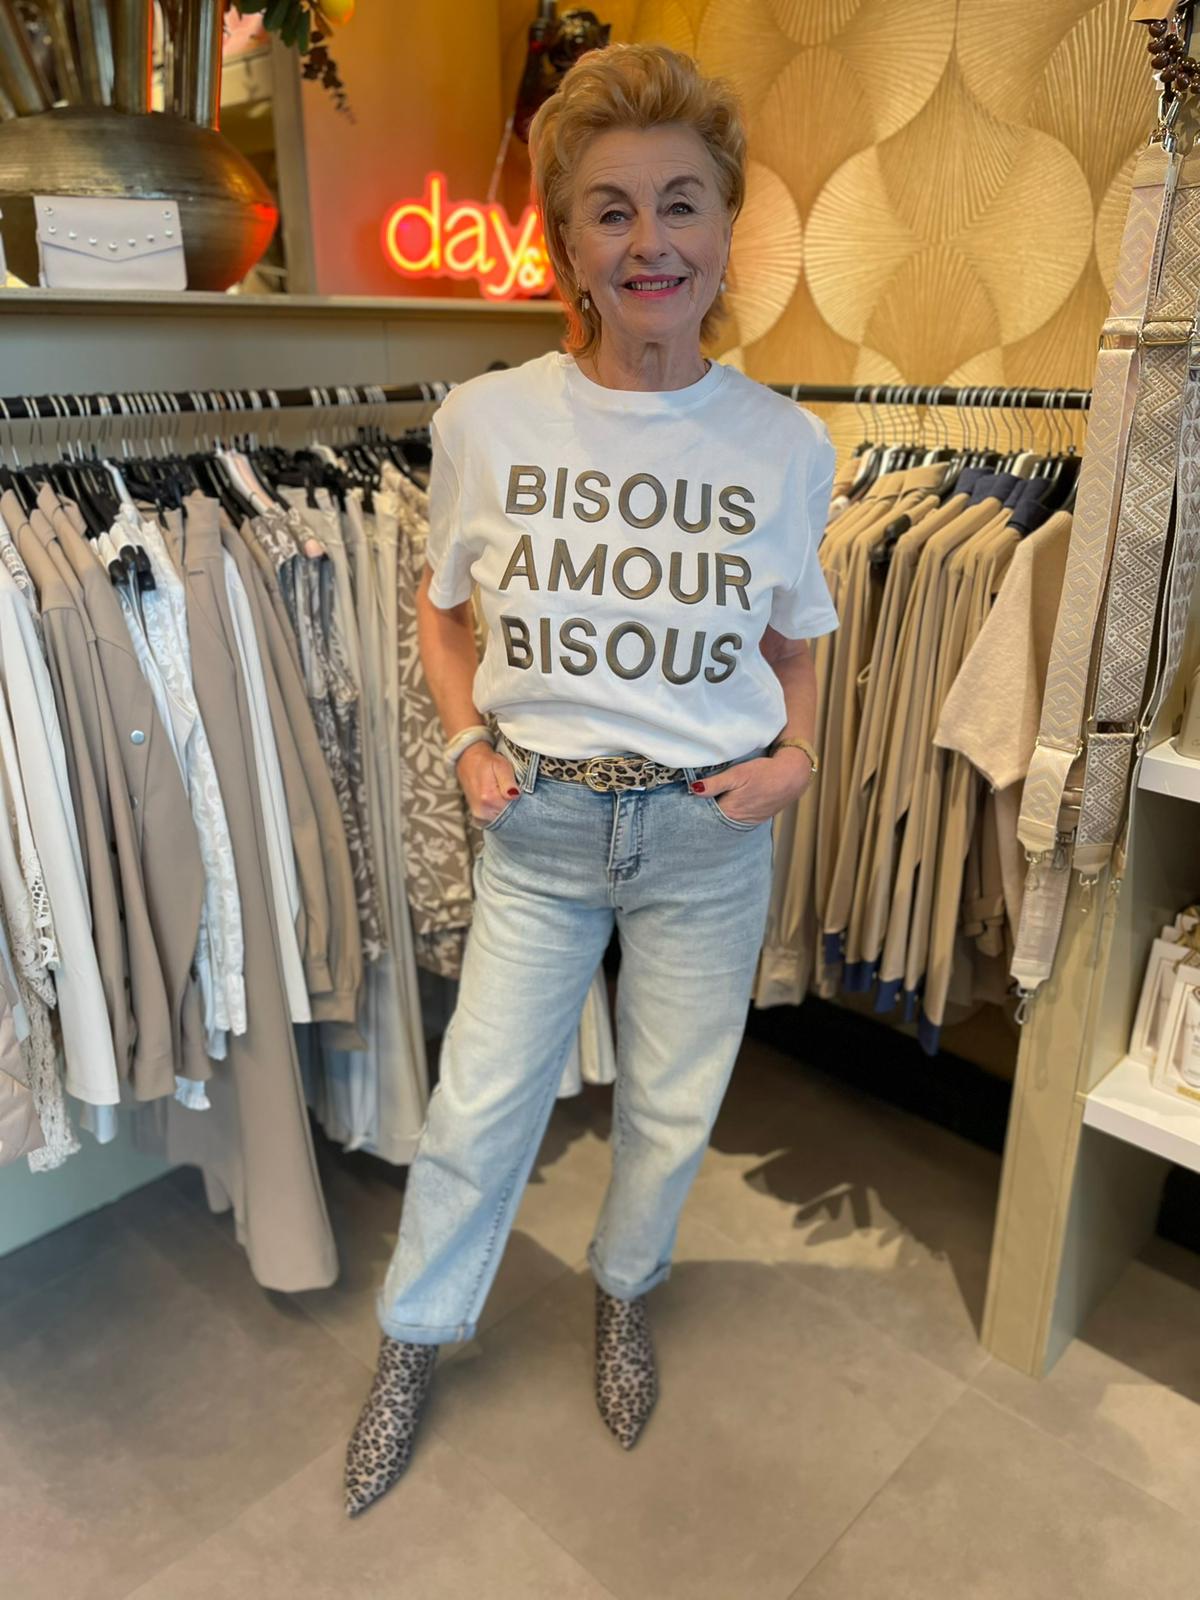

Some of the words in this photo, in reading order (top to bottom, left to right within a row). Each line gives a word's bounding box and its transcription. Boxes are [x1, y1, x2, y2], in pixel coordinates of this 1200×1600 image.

[387, 177, 538, 295] day
[505, 464, 755, 535] BISOUS
[498, 534, 752, 610] AMOUR
[500, 614, 742, 685] BISOUS
